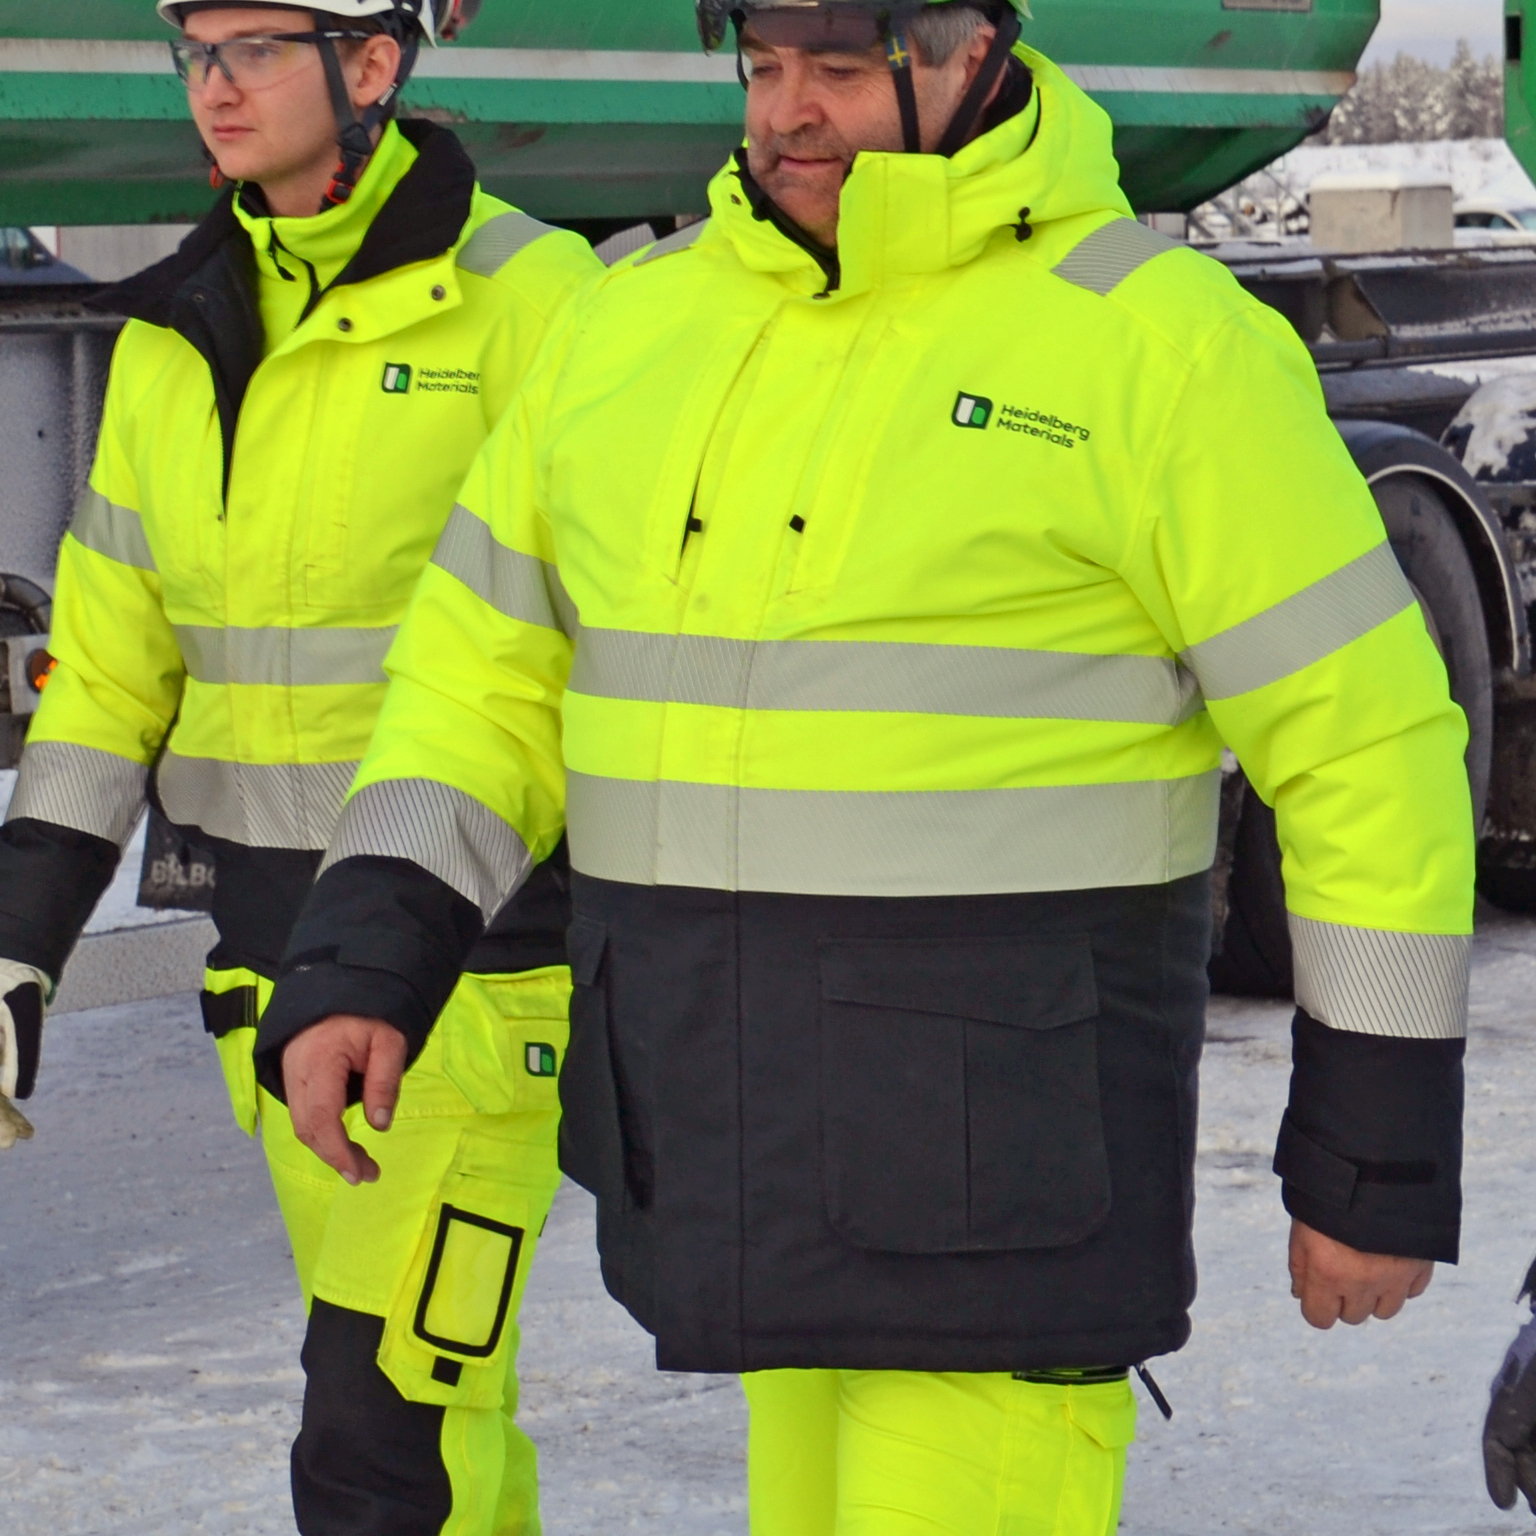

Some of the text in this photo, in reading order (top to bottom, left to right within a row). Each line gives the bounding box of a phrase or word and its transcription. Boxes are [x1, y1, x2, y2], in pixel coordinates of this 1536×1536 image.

[419, 367, 480, 381] Heidelber
[995, 417, 1076, 449] Materials
[1000, 403, 1091, 442] Heidelberg
